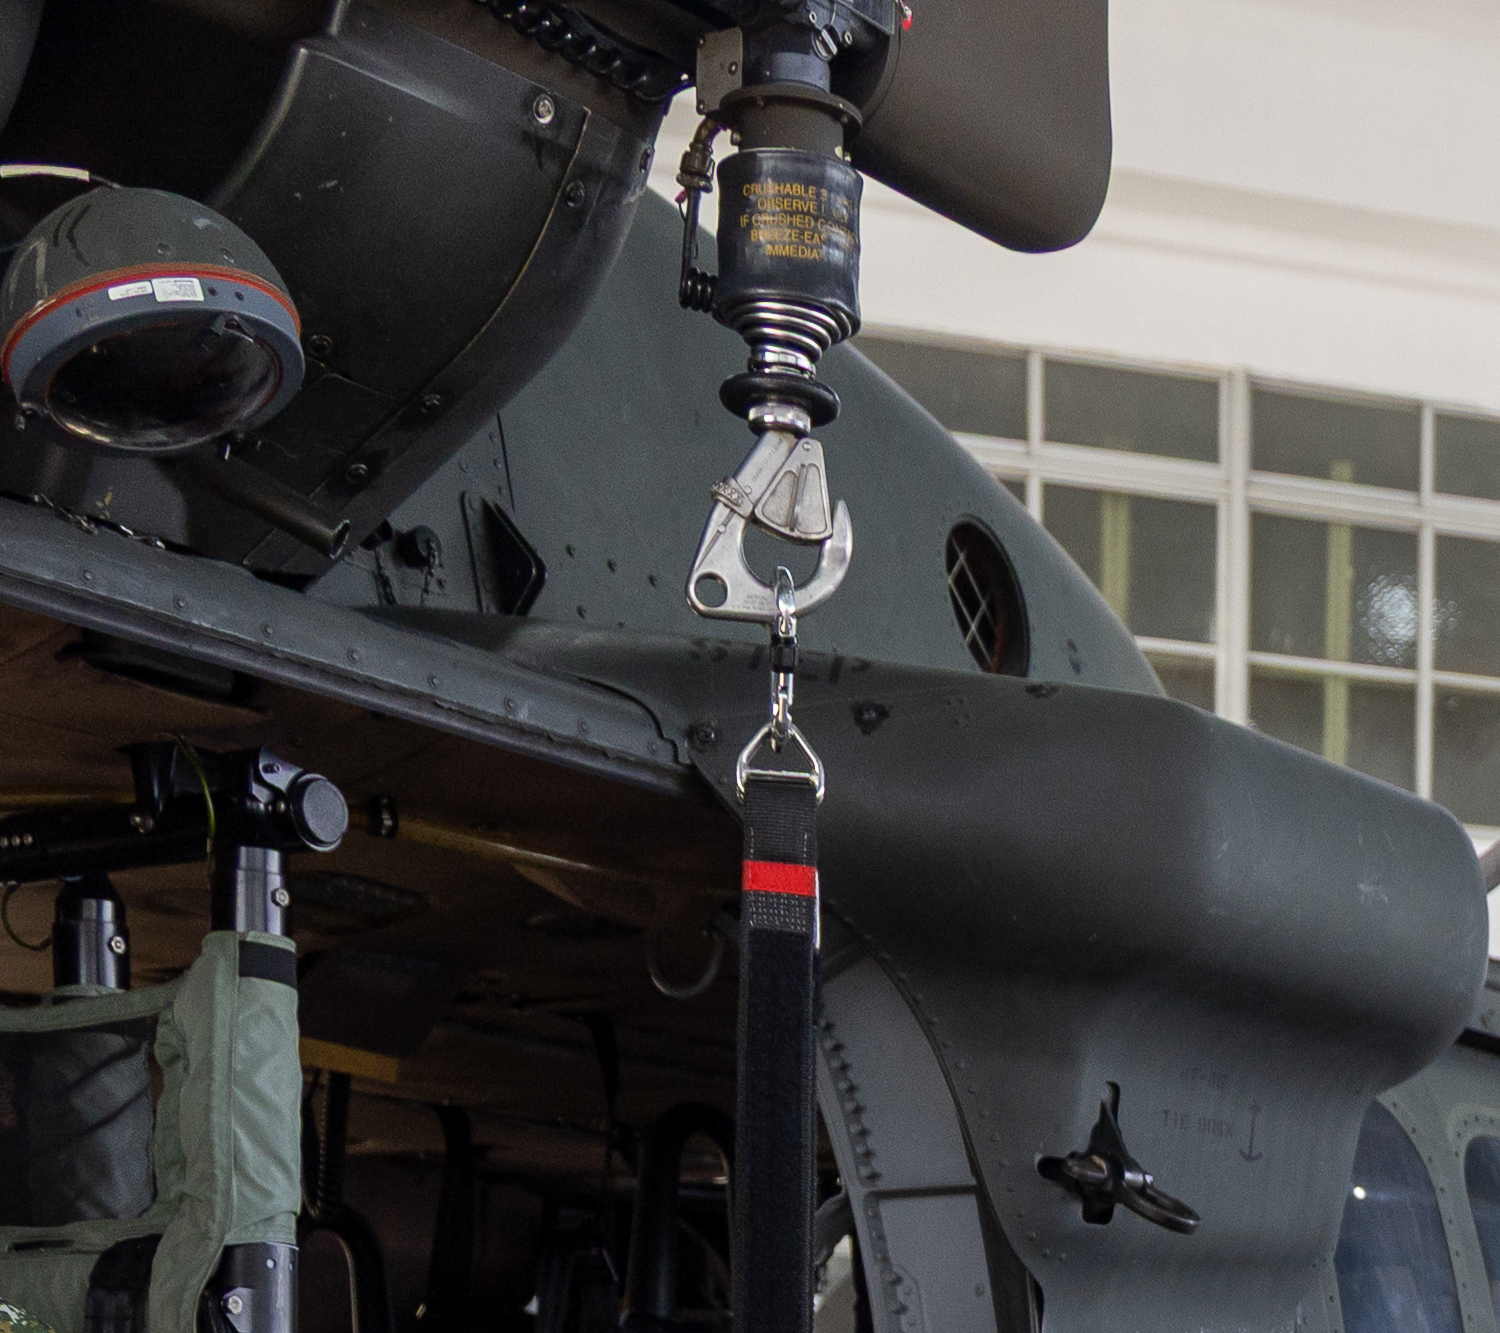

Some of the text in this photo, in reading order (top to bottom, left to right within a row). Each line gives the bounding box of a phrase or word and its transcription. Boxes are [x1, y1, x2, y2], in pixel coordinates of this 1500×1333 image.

[742, 182, 817, 198] CRUSHABLE
[757, 197, 818, 213] OBSERVE
[740, 215, 749, 227] IF
